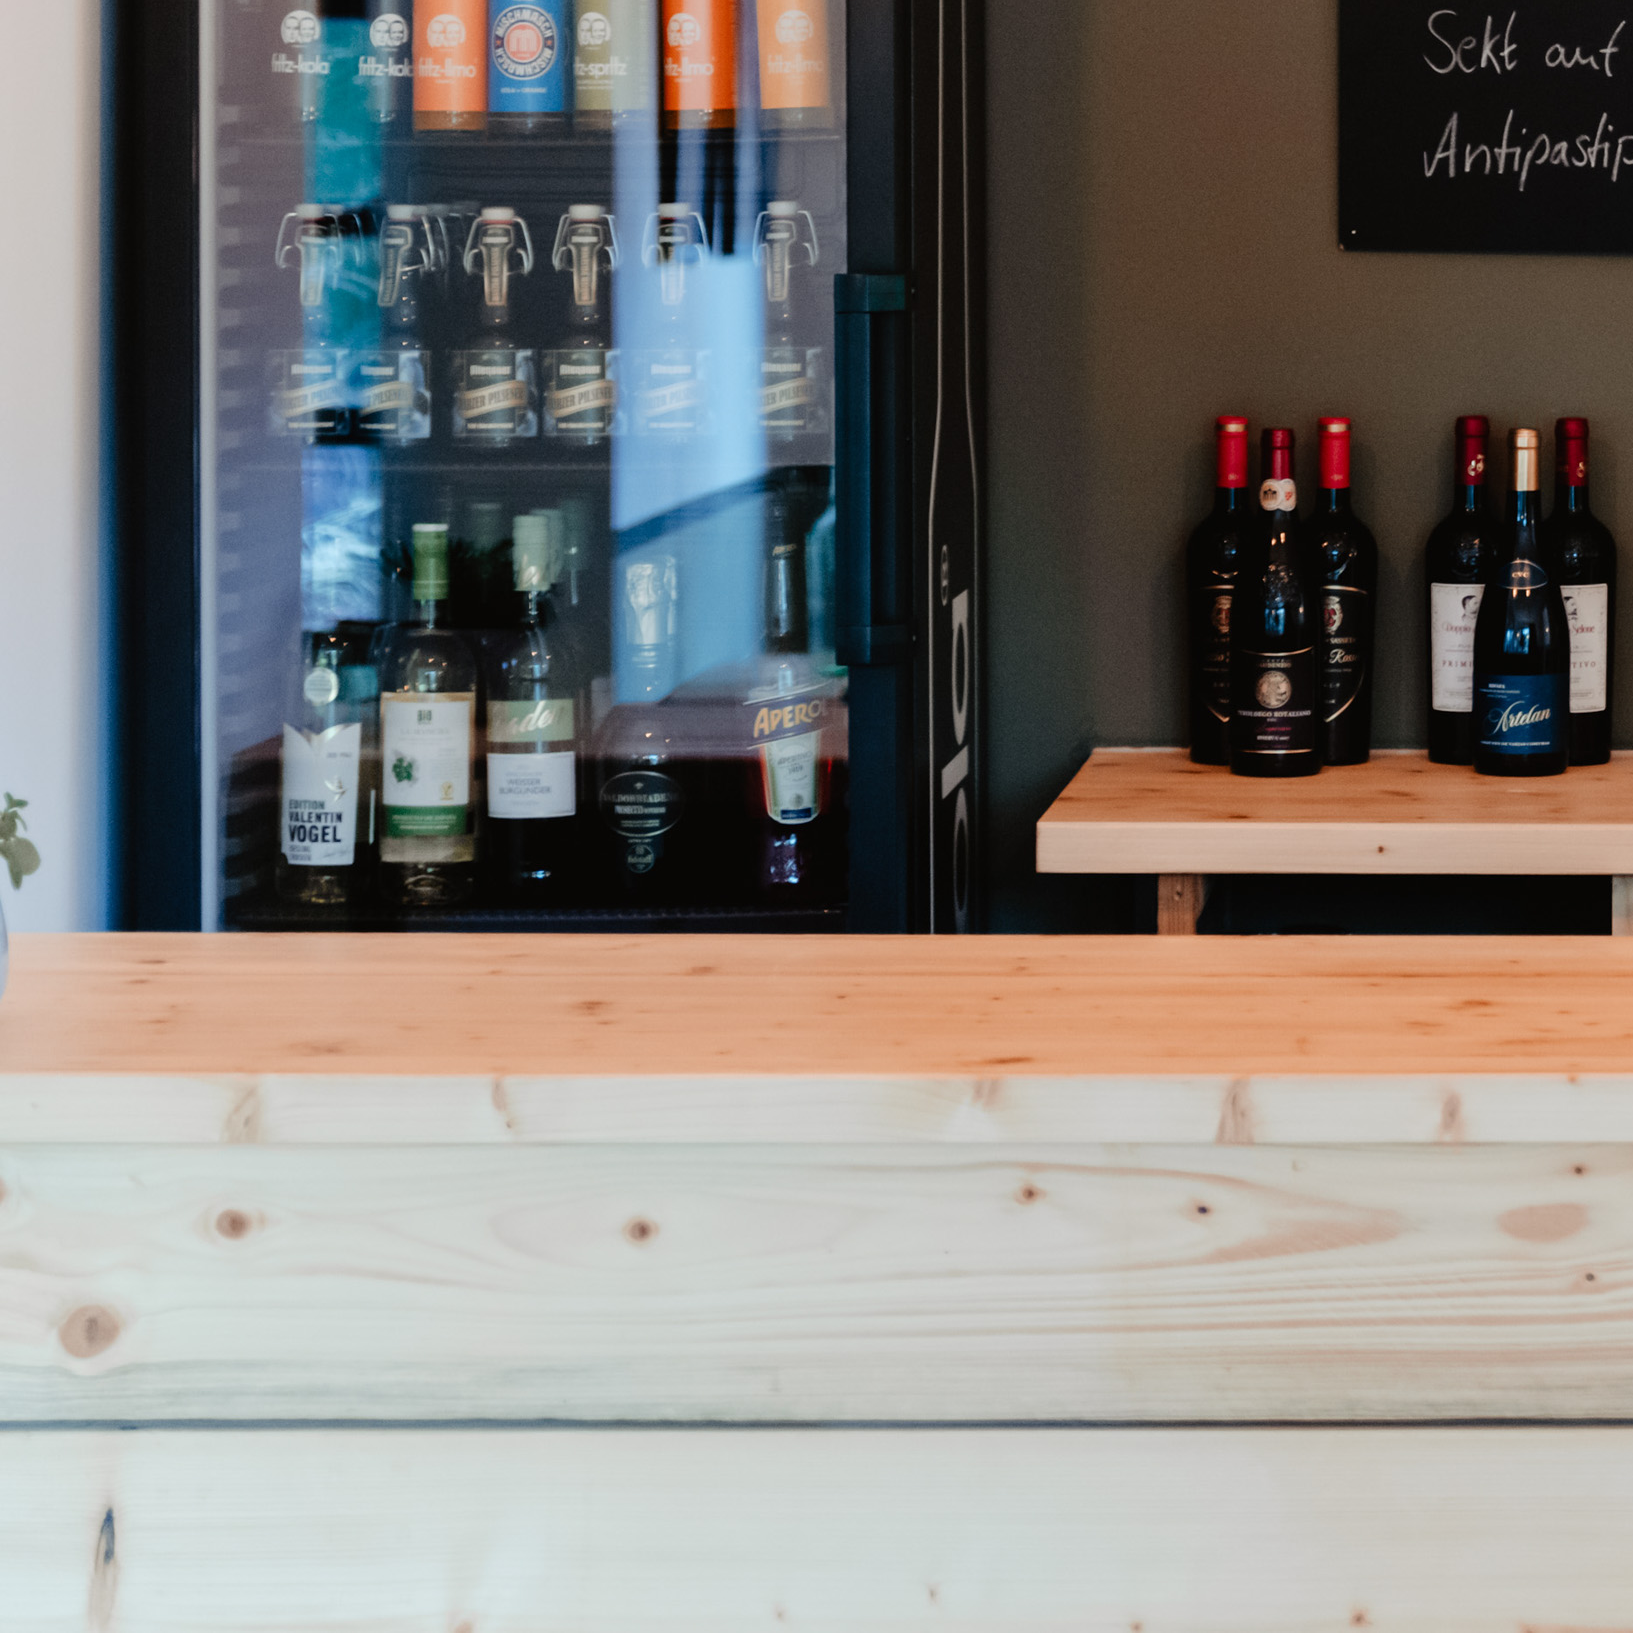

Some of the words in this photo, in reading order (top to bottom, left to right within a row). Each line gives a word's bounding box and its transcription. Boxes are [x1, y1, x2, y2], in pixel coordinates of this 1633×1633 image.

[1424, 10, 1517, 74] Sekt
[1545, 21, 1626, 77] auf
[289, 799, 325, 810] EDITION
[289, 811, 343, 823] VALENTIN
[288, 824, 342, 843] VOGEL
